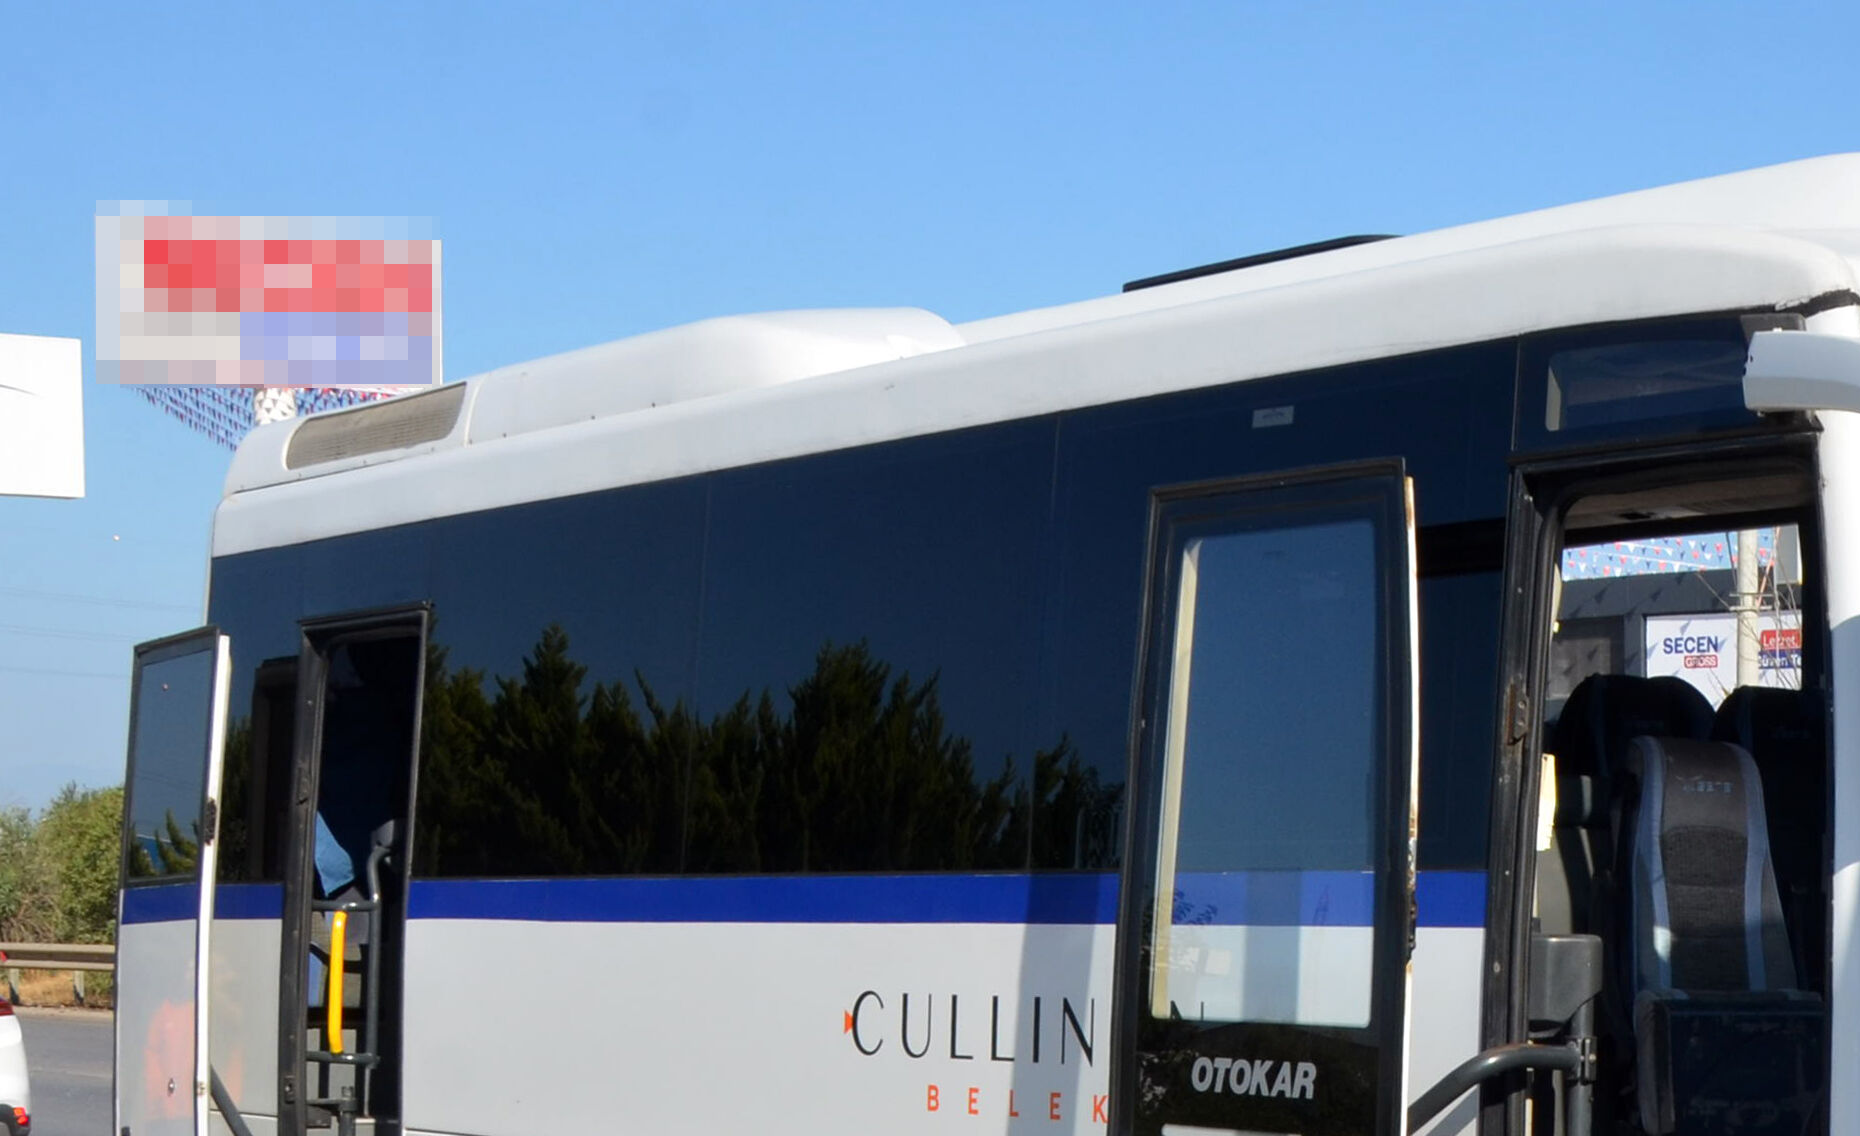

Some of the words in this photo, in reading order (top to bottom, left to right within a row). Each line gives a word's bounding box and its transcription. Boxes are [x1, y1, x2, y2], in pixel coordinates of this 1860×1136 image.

[852, 990, 1095, 1067] CULLIN
[1191, 1056, 1317, 1099] OTOKAR
[927, 1084, 1108, 1123] BELEK
